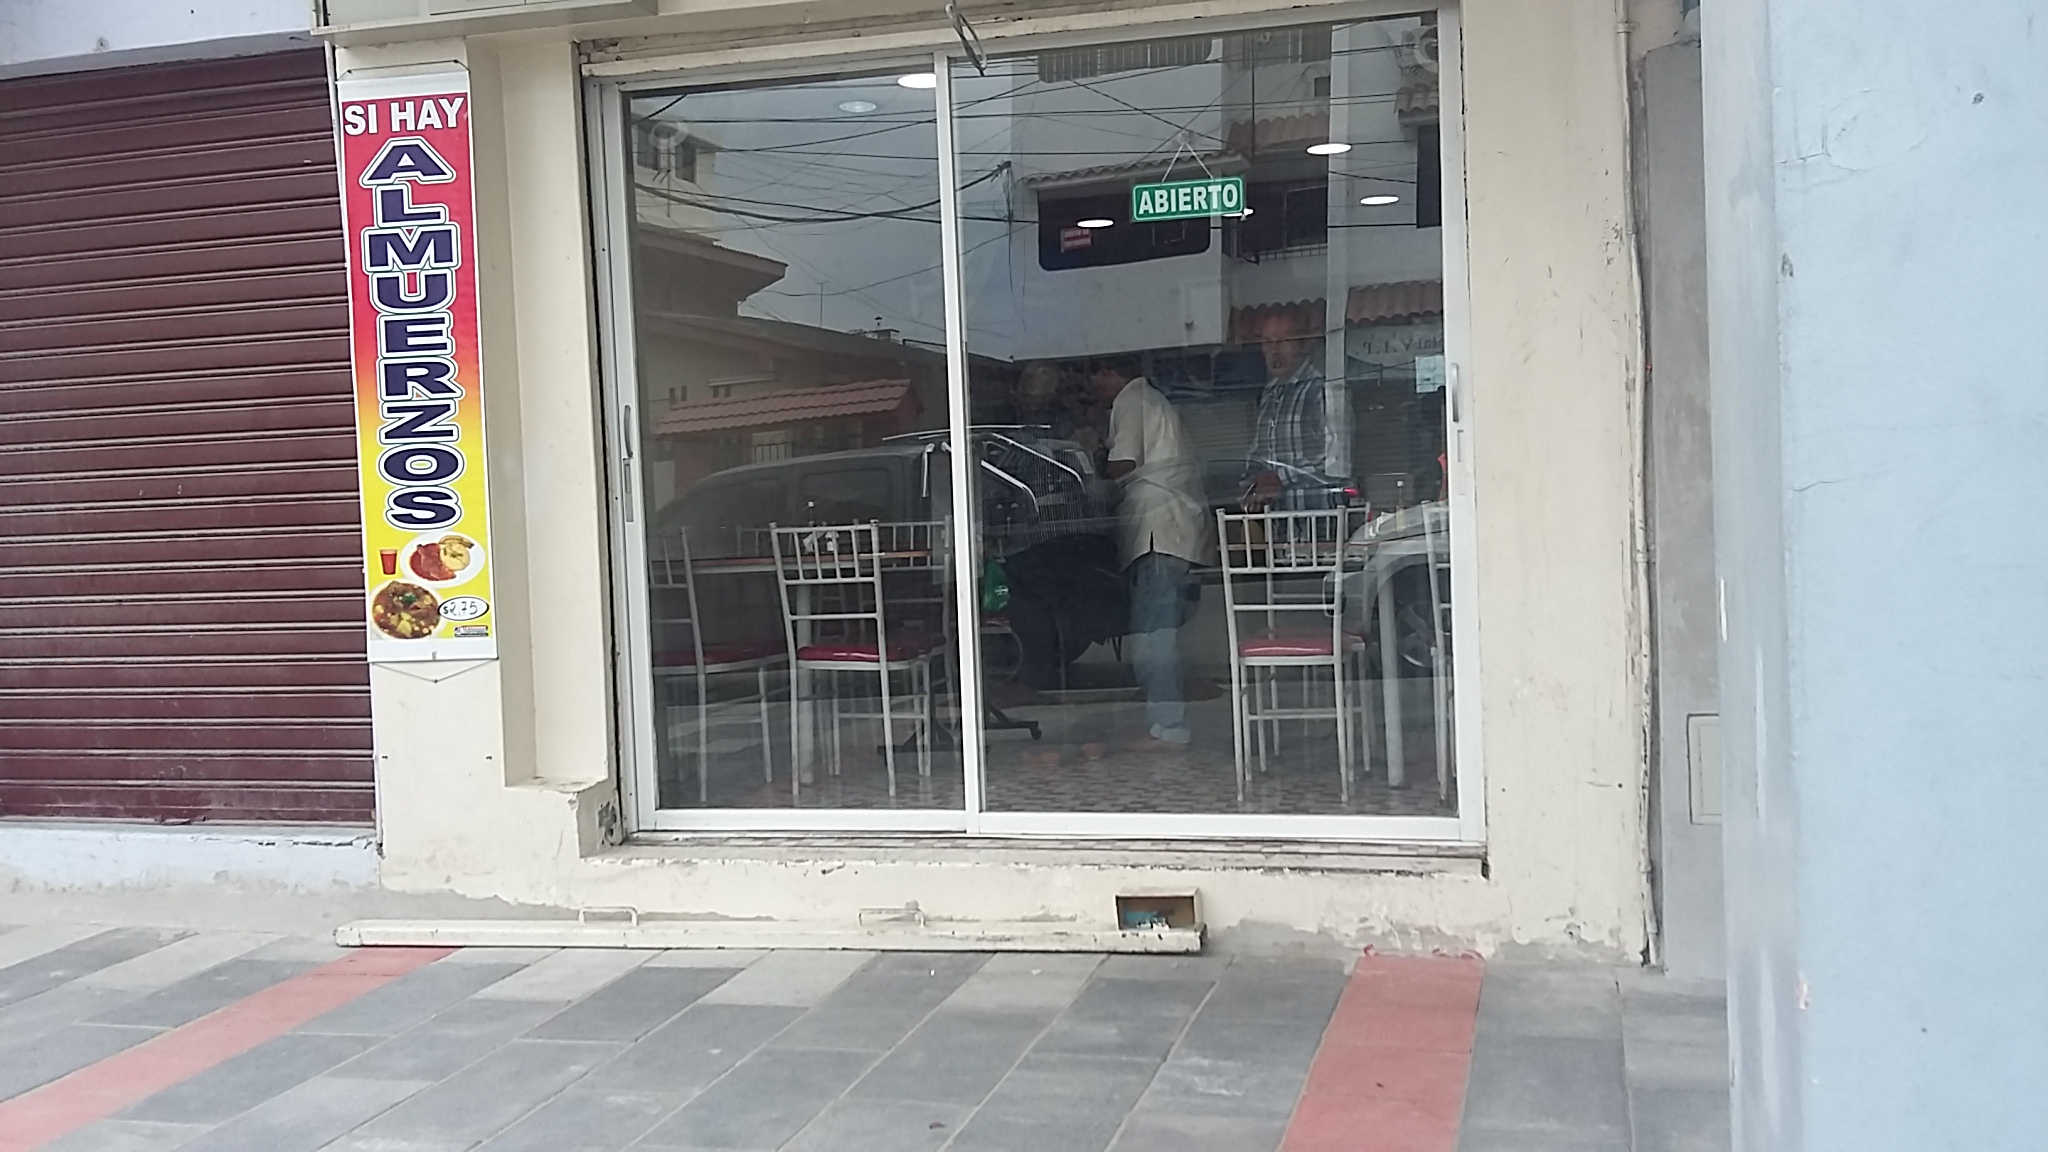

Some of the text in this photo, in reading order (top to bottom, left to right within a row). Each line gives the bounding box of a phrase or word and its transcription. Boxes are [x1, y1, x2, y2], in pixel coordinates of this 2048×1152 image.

[343, 97, 465, 136] SI HAY
[1138, 183, 1239, 215] ABIERTO
[359, 136, 466, 530] ALMUERZOS
